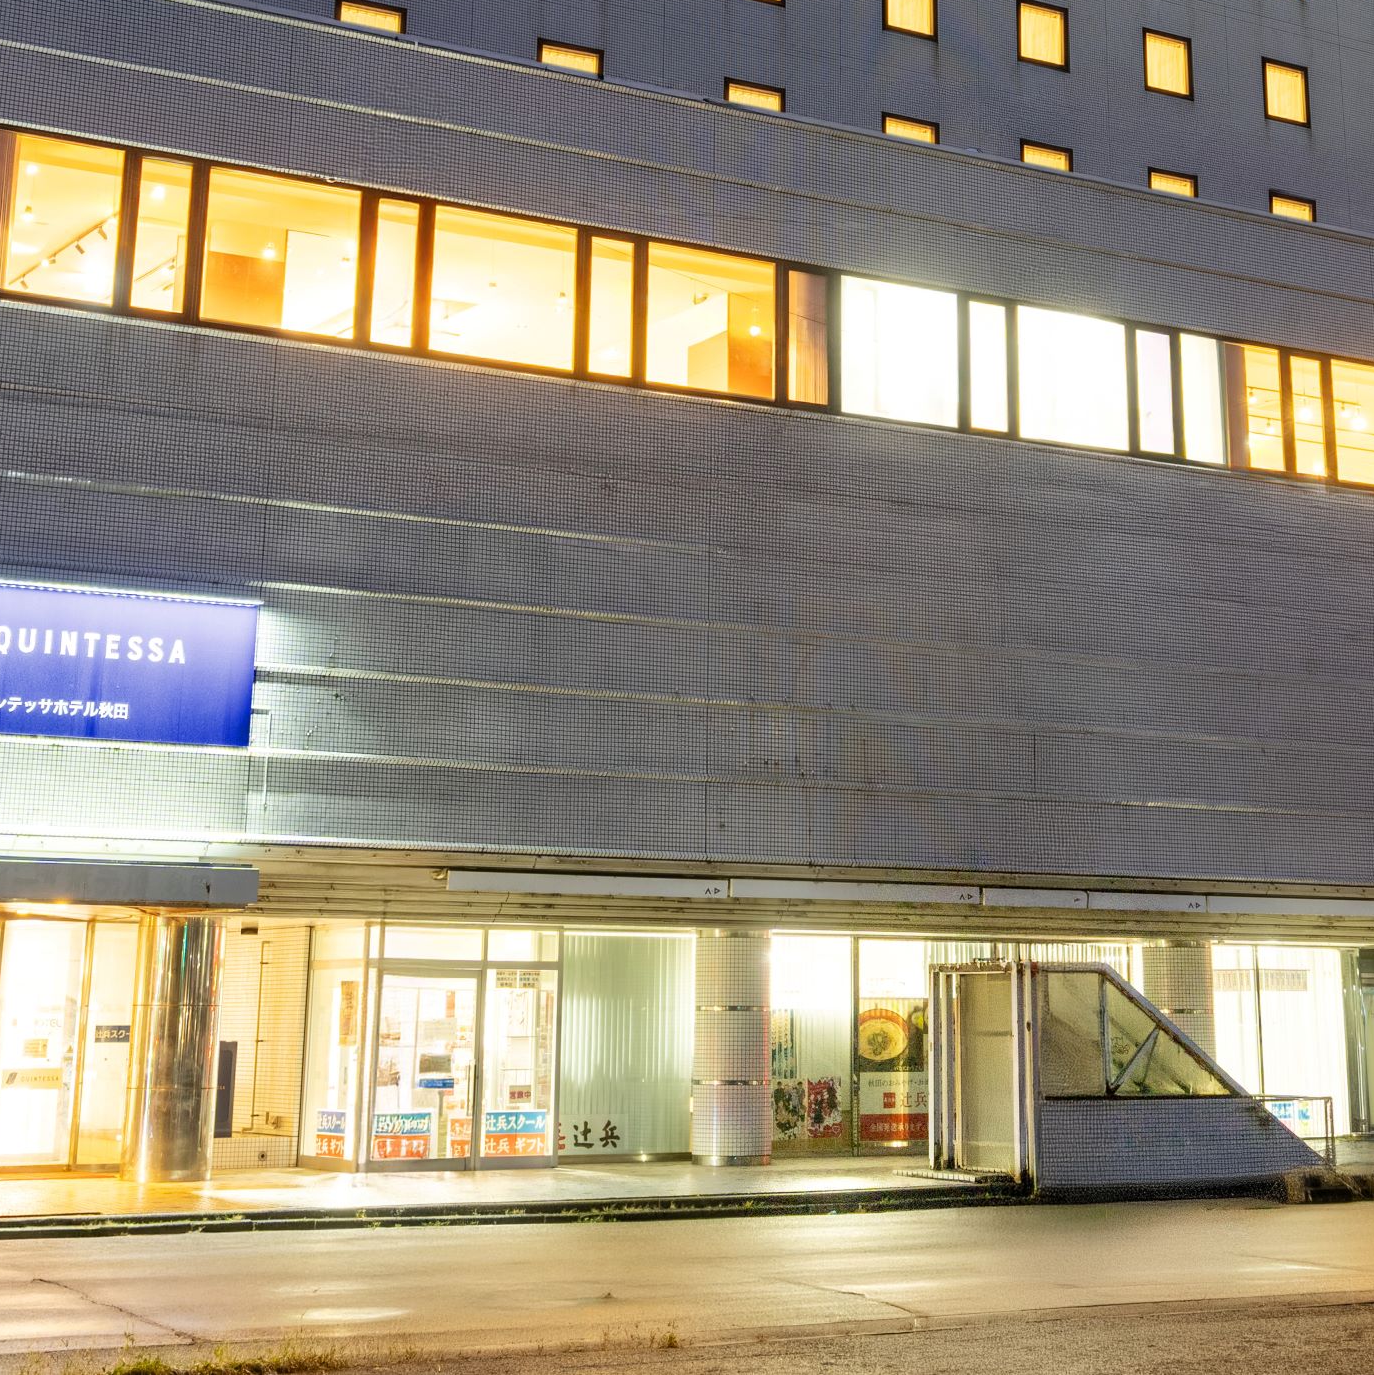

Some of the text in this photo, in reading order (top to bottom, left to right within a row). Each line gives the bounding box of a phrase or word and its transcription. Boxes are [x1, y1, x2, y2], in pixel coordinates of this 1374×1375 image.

[485, 1115, 545, 1131] 辻兵スクール
[573, 1119, 621, 1149] 辻兵
